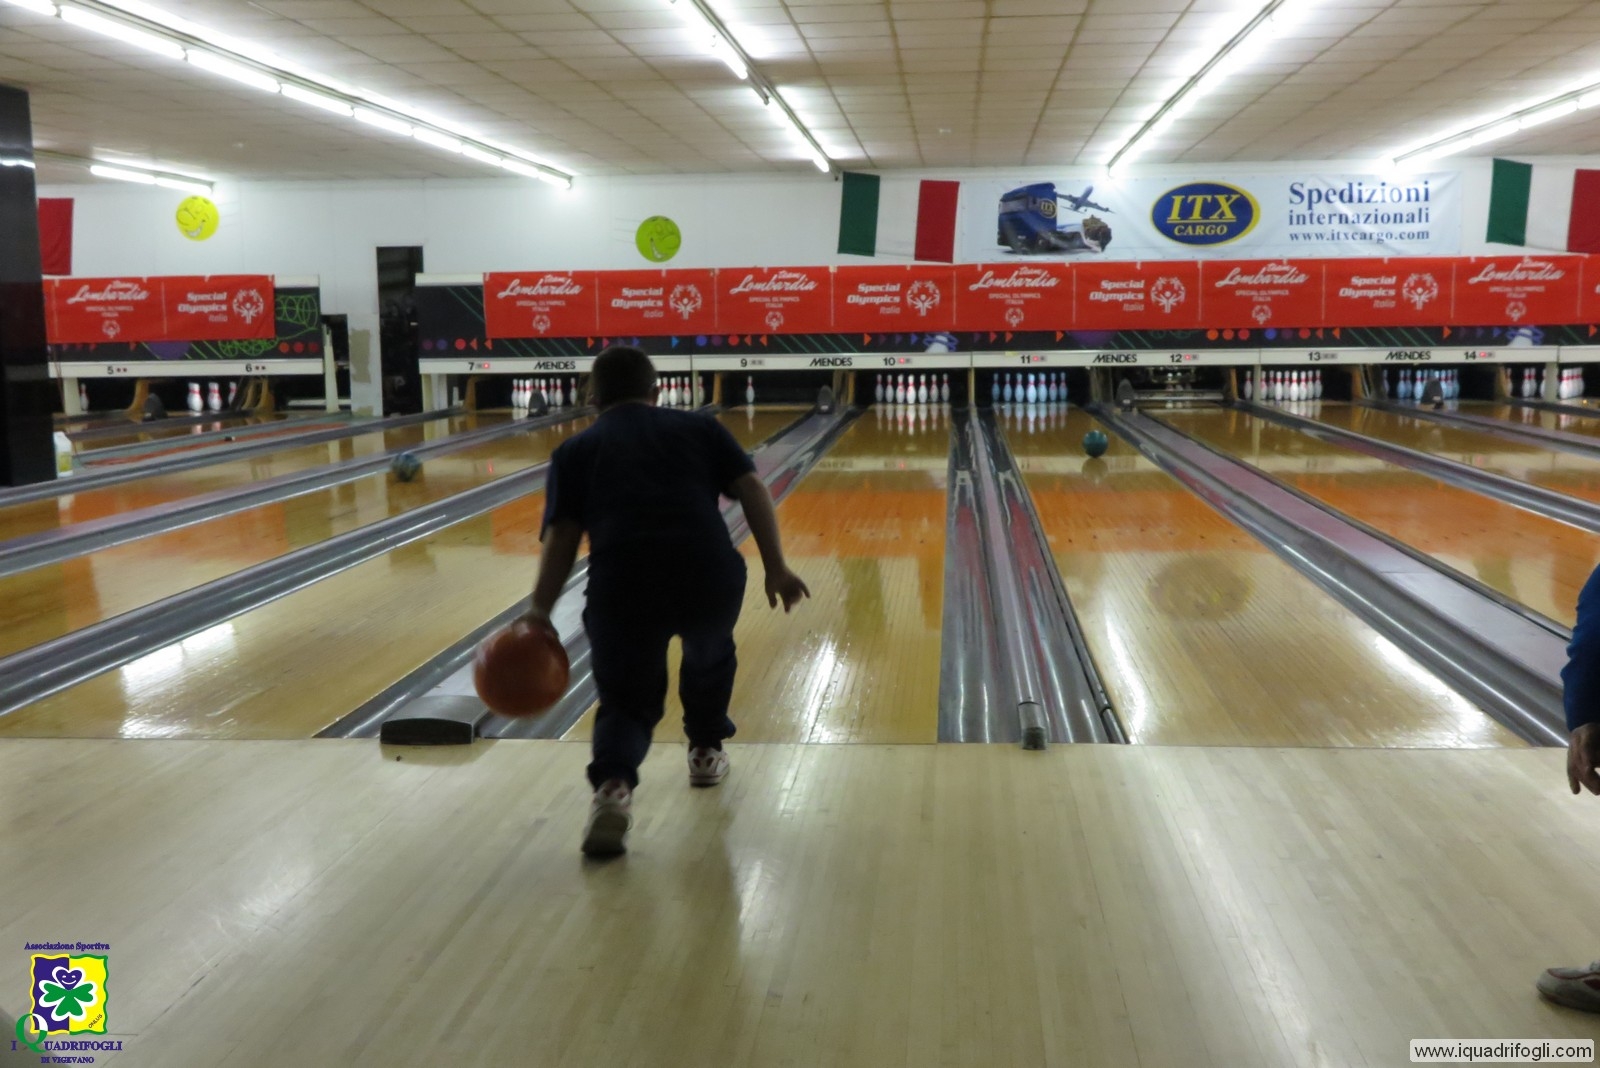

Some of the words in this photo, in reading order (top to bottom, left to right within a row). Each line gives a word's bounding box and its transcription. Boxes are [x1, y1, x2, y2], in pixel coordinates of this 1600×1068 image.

[1289, 181, 1430, 210] Spedizioni
[1167, 194, 1240, 220] ITX
[1289, 208, 1430, 225] internazionali
[1173, 225, 1228, 236] CARGO
[1289, 230, 1430, 244] www.itxcargo.com
[1215, 267, 1310, 287] Lombardia
[1468, 263, 1565, 284] Lombardia
[729, 274, 818, 294] Lombardia
[969, 270, 1061, 291] Lombardia
[1100, 280, 1145, 291] Special
[1351, 275, 1397, 286] Special
[497, 279, 583, 298] Lombardia
[621, 287, 664, 298] Special
[858, 283, 900, 294] Special
[1339, 287, 1396, 298] Olympics
[187, 292, 228, 303] Special
[847, 294, 900, 305] Olympics
[1089, 291, 1145, 302] Olympics
[178, 303, 228, 315] Olympics
[611, 299, 664, 310] Olympics
[1020, 355, 1031, 364] 11
[1092, 354, 1137, 364] MENDES
[1170, 354, 1182, 363] 12
[1308, 352, 1321, 361] 13
[1385, 351, 1432, 360] MENDES
[1464, 351, 1477, 360] 14
[468, 362, 475, 371] 7
[533, 361, 576, 371] MENDES
[740, 358, 748, 368] 9
[809, 357, 853, 367] MENDES
[883, 357, 896, 366] 10
[107, 366, 114, 375] 5
[245, 363, 252, 372] 6
